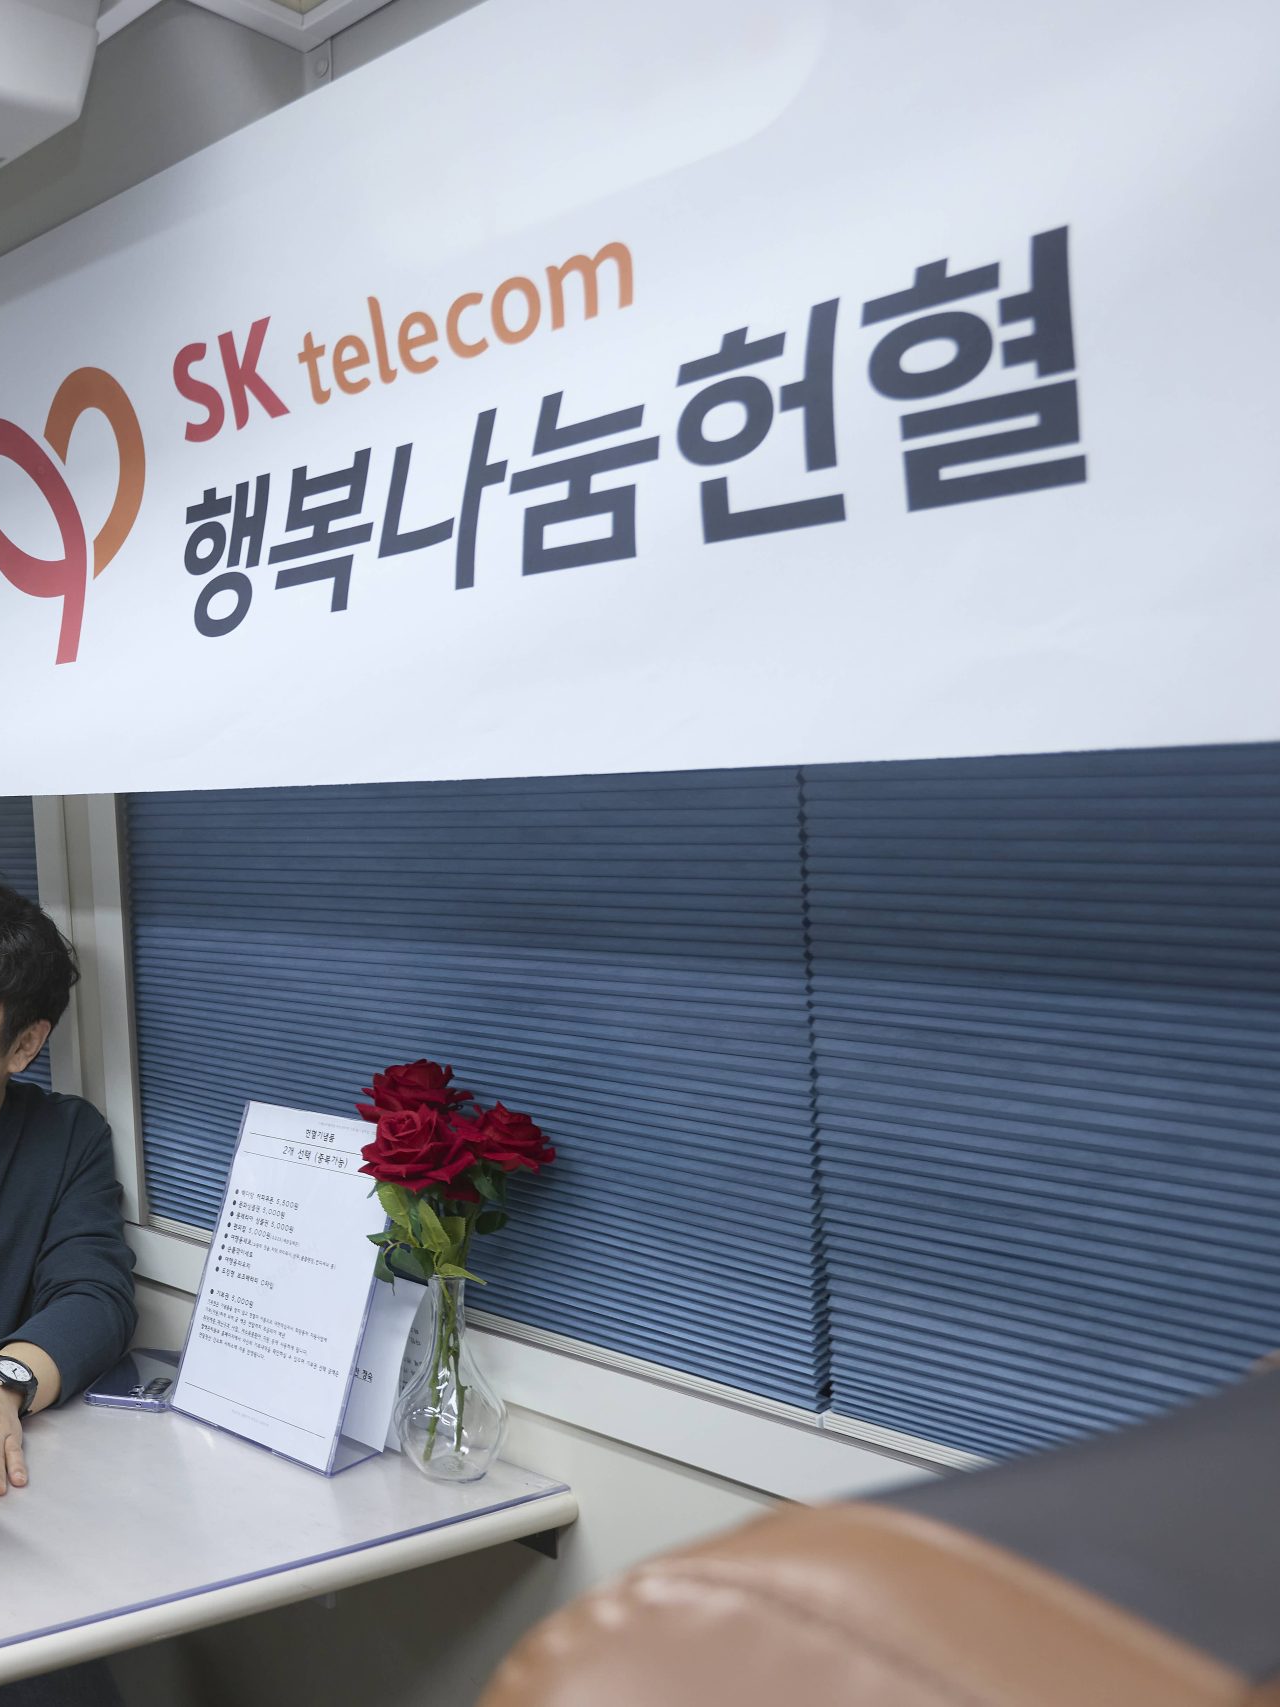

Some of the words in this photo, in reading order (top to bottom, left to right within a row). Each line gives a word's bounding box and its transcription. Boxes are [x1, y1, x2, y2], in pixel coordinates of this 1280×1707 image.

[173, 315, 290, 443] SK
[297, 241, 635, 406] telecom
[282, 1145, 294, 1156] 2개
[297, 1149, 312, 1161] 선택
[314, 1152, 348, 1168] (중복가능)
